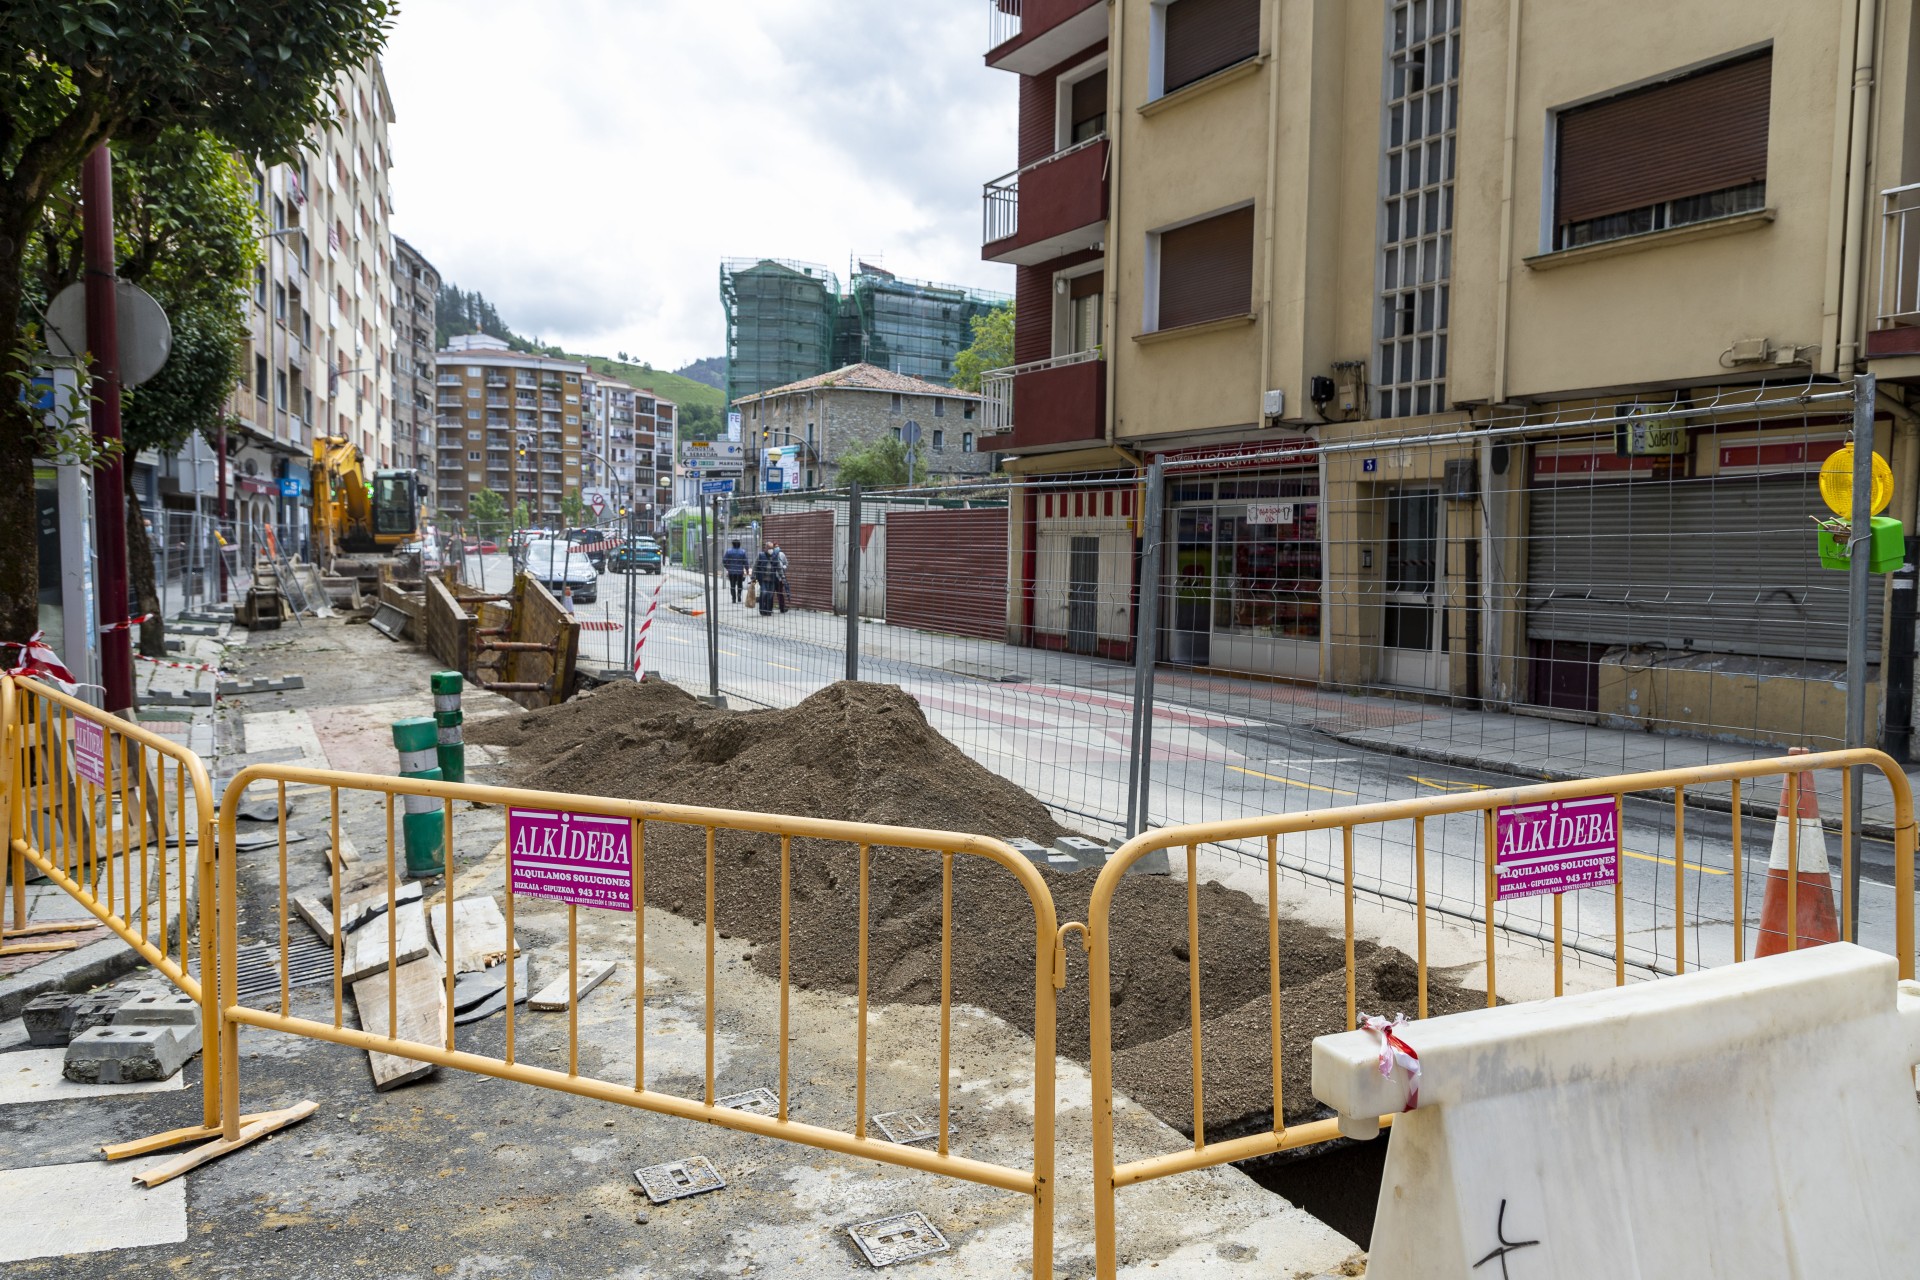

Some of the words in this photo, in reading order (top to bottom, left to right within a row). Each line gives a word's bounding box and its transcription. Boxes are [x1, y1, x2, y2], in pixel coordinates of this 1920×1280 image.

[1366, 460, 1373, 471] 3
[1560, 856, 1616, 871] SOLUCIONES
[513, 868, 572, 882] ALQUILAMOS
[573, 873, 631, 888] SOLUCIONES
[1500, 883, 1527, 892] BIZKAIA
[1530, 877, 1563, 888] GIPUZKOA
[1565, 873, 1581, 884] 943
[1582, 872, 1592, 881] 17
[1594, 870, 1604, 879] 13
[1605, 869, 1615, 877] 62
[514, 881, 540, 891] BIZKAIA
[543, 884, 575, 895] GIPUZKOA
[578, 887, 593, 897] 943
[595, 889, 605, 899] 17
[607, 891, 617, 900] 13
[619, 891, 630, 900] 62
